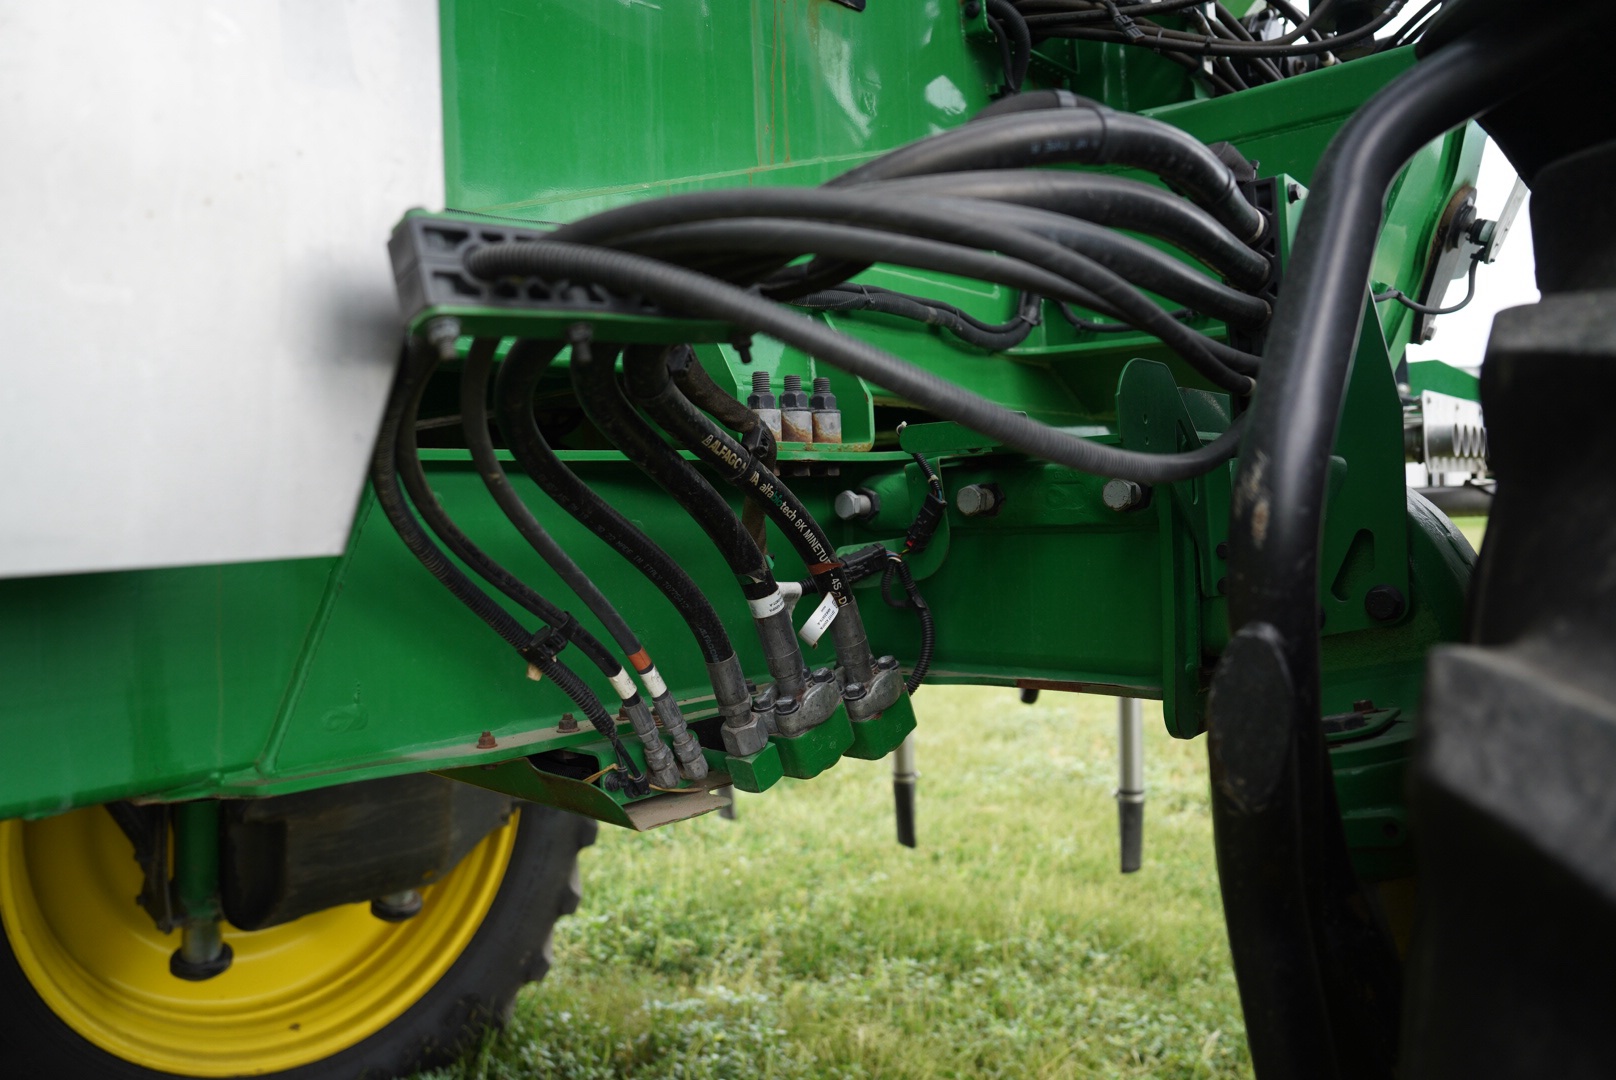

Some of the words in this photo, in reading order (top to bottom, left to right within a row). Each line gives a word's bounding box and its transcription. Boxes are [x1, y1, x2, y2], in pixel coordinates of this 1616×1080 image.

[708, 440, 760, 486] ALFAGOA
[759, 482, 797, 521] alfabiotech
[794, 518, 808, 532] 6K
[803, 529, 832, 570] MINETU
[831, 578, 842, 591] 4S
[643, 563, 663, 581] ITALY
